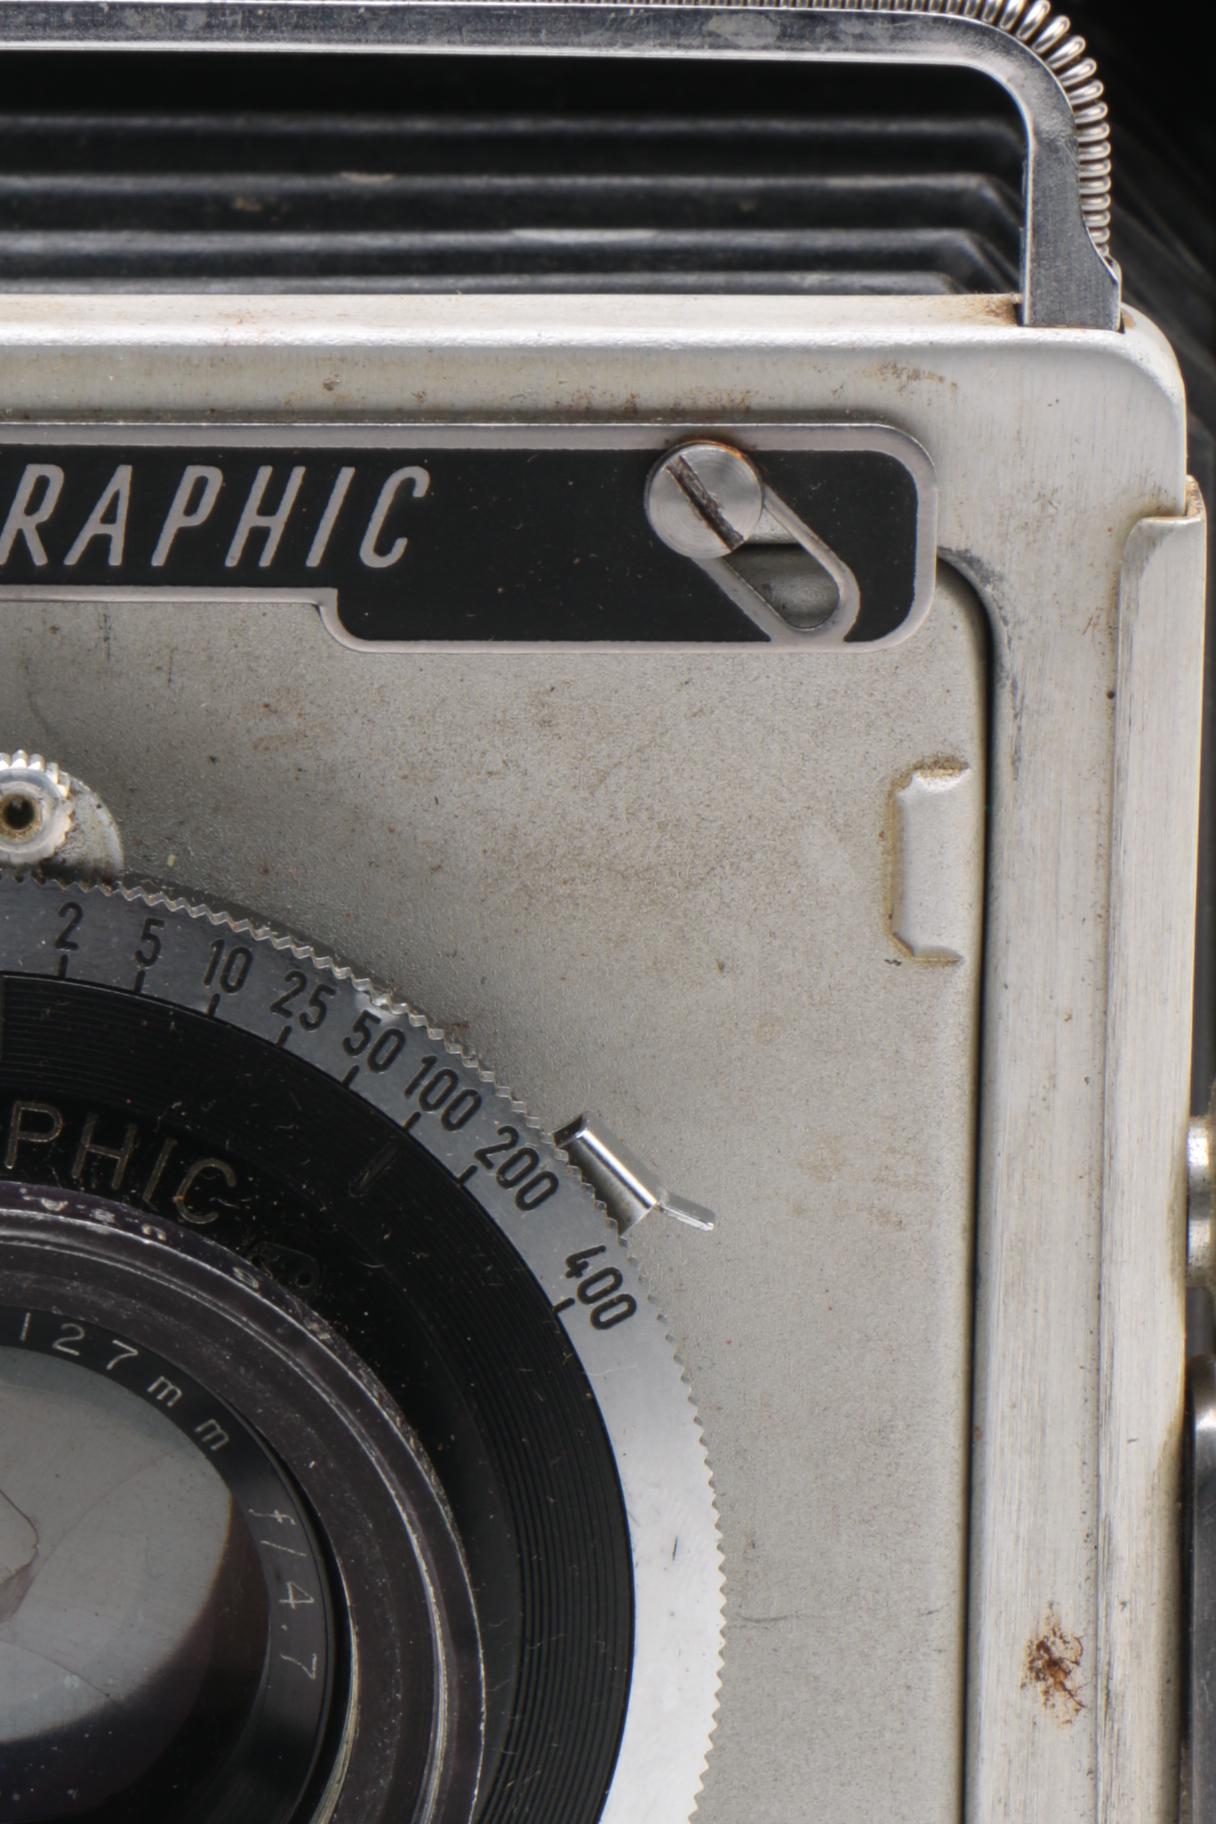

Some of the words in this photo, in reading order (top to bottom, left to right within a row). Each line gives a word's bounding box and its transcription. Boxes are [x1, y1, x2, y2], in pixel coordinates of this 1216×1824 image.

[53, 901, 84, 951] 2
[134, 917, 166, 968] 5
[203, 938, 254, 995] 10
[270, 969, 337, 1033] 25
[342, 1009, 407, 1075] 50
[404, 1055, 483, 1132] 100
[473, 1125, 560, 1212] 200
[564, 1245, 638, 1331] 400
